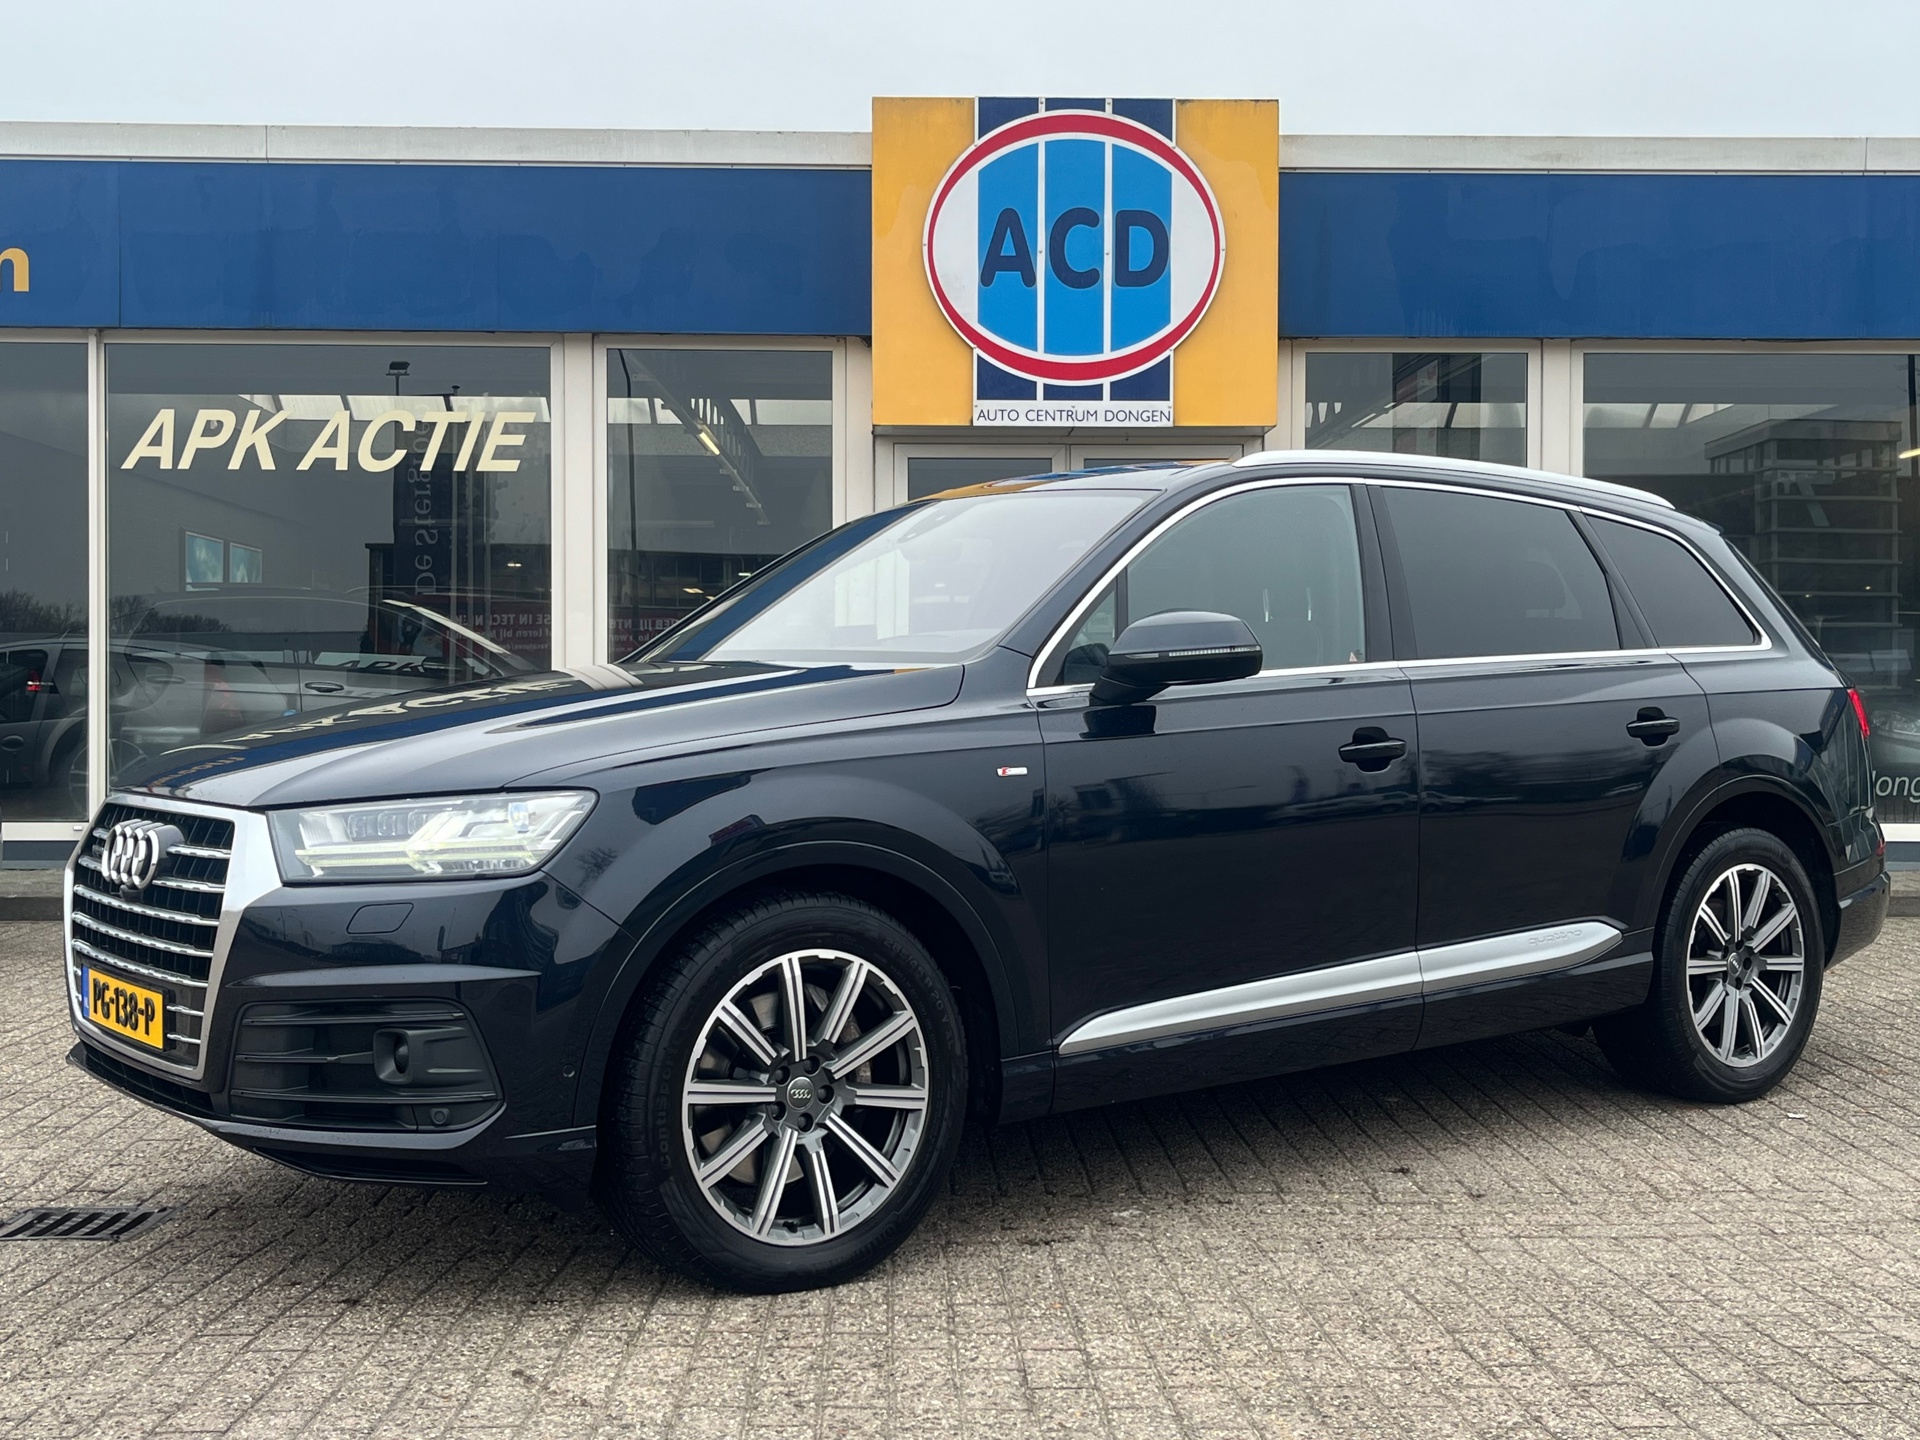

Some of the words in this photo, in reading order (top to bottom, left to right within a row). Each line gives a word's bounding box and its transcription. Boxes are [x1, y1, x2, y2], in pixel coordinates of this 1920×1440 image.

[980, 207, 1168, 289] ACD
[121, 409, 291, 470] APK
[296, 410, 537, 472] ACTIE
[976, 409, 1020, 422] AUTO
[1025, 409, 1099, 423] CENTRUM
[1104, 409, 1172, 424] DONGEN
[93, 978, 155, 1036] PG-138-P
